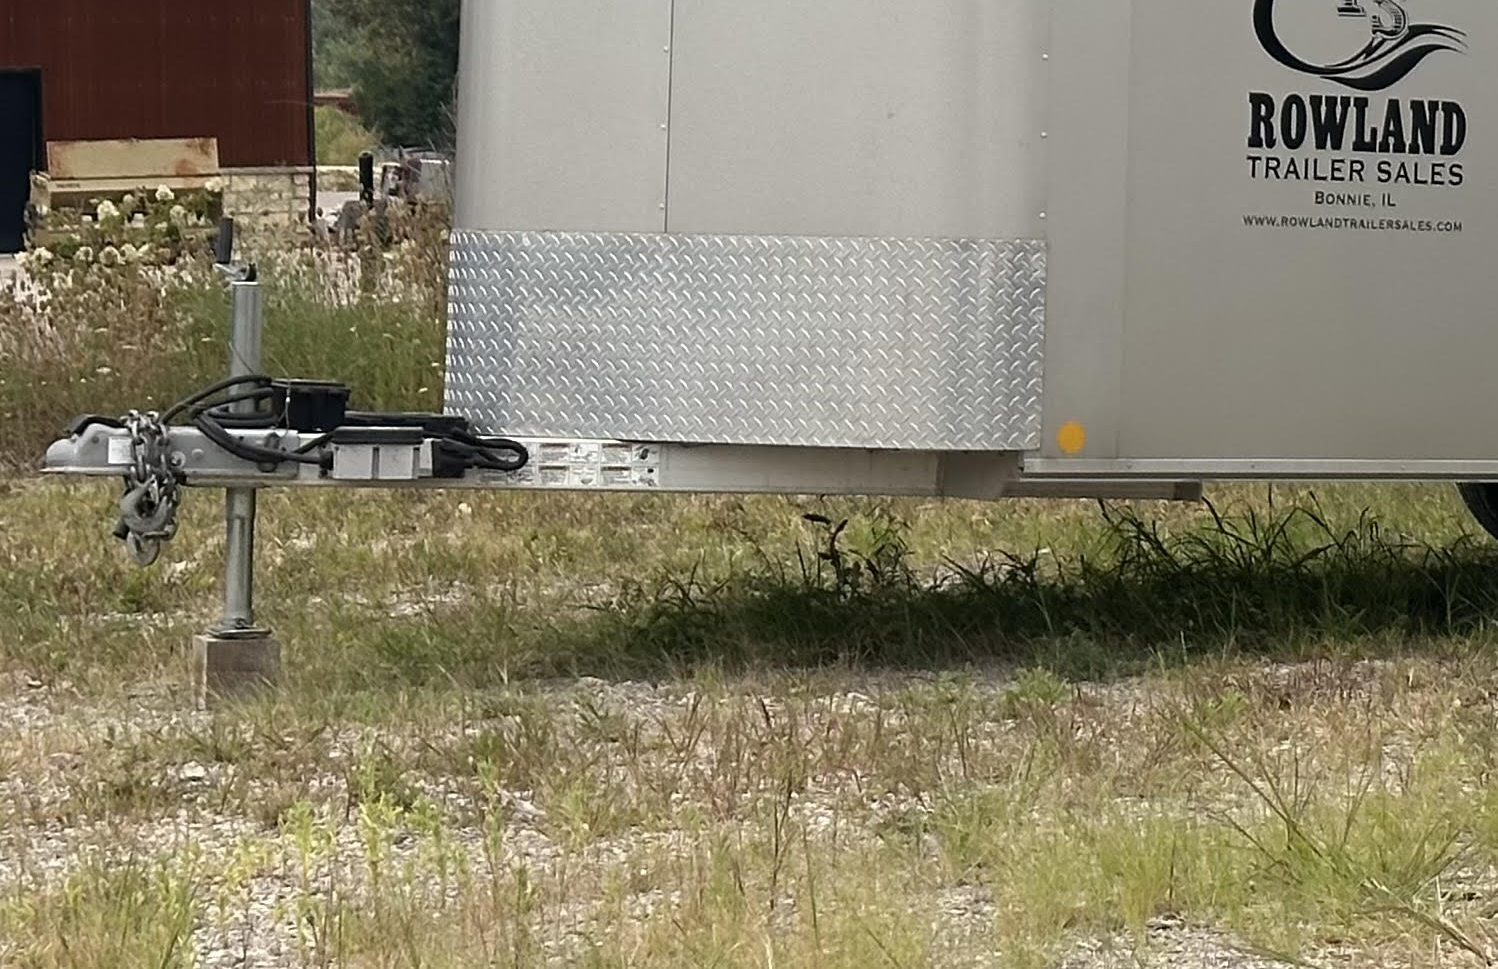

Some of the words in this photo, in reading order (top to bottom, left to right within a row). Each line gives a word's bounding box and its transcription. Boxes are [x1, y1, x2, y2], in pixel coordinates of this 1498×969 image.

[1247, 91, 1467, 156] ROWLAND
[1246, 155, 1366, 182] TRAILER
[1376, 160, 1464, 186] SALES
[1381, 192, 1397, 208] IL
[1242, 214, 1463, 233] WWW.ROWLANDTRAILERSALES.COM
